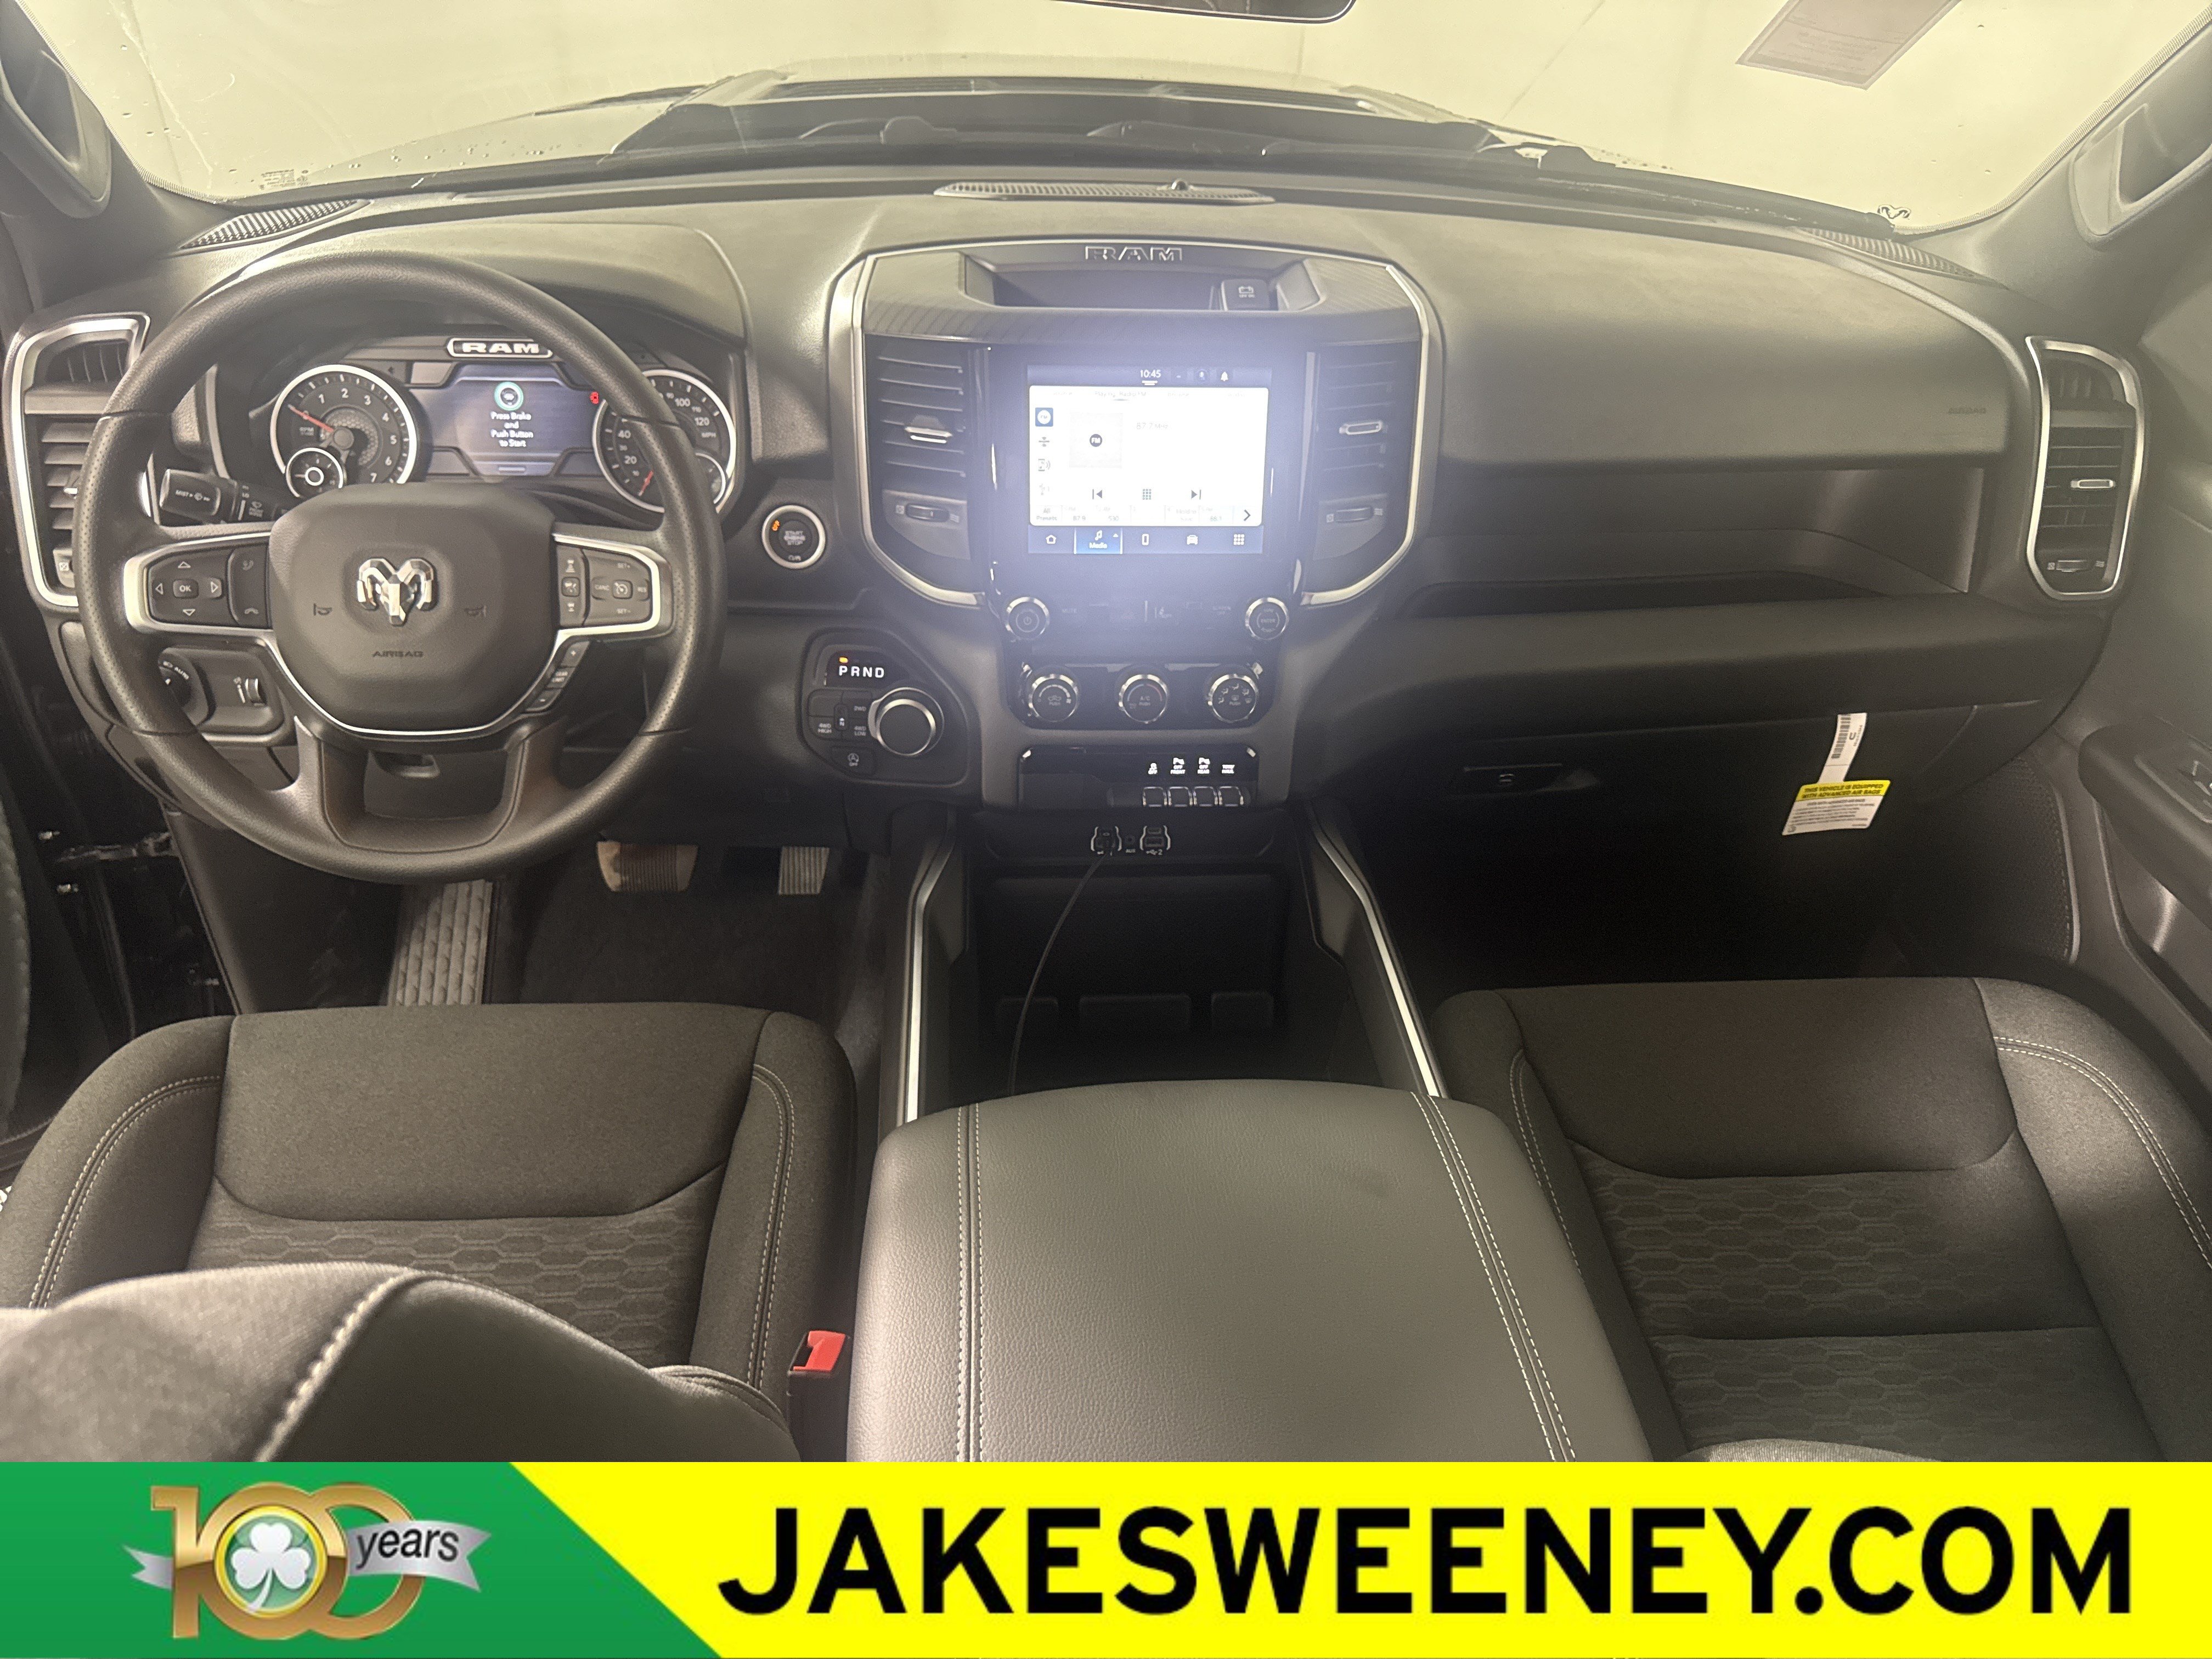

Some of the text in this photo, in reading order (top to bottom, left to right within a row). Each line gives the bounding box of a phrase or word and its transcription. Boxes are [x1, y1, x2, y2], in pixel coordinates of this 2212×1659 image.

[1085, 246, 1182, 261] RAM
[462, 342, 539, 354] RAM
[1140, 369, 1161, 379] 10:45
[342, 388, 349, 398] 2
[319, 394, 325, 403] 1
[364, 395, 371, 405] 3
[675, 398, 691, 407] 100
[382, 413, 390, 422] 4
[490, 411, 532, 420] Press Brake
[695, 417, 710, 426] 120
[490, 429, 534, 438] Push Button
[618, 430, 631, 438] 40
[390, 435, 397, 444] 5
[508, 439, 526, 447] Start
[385, 456, 392, 466] 6
[624, 455, 637, 464] 20
[370, 472, 377, 482] 7
[174, 667, 189, 680] AUTO
